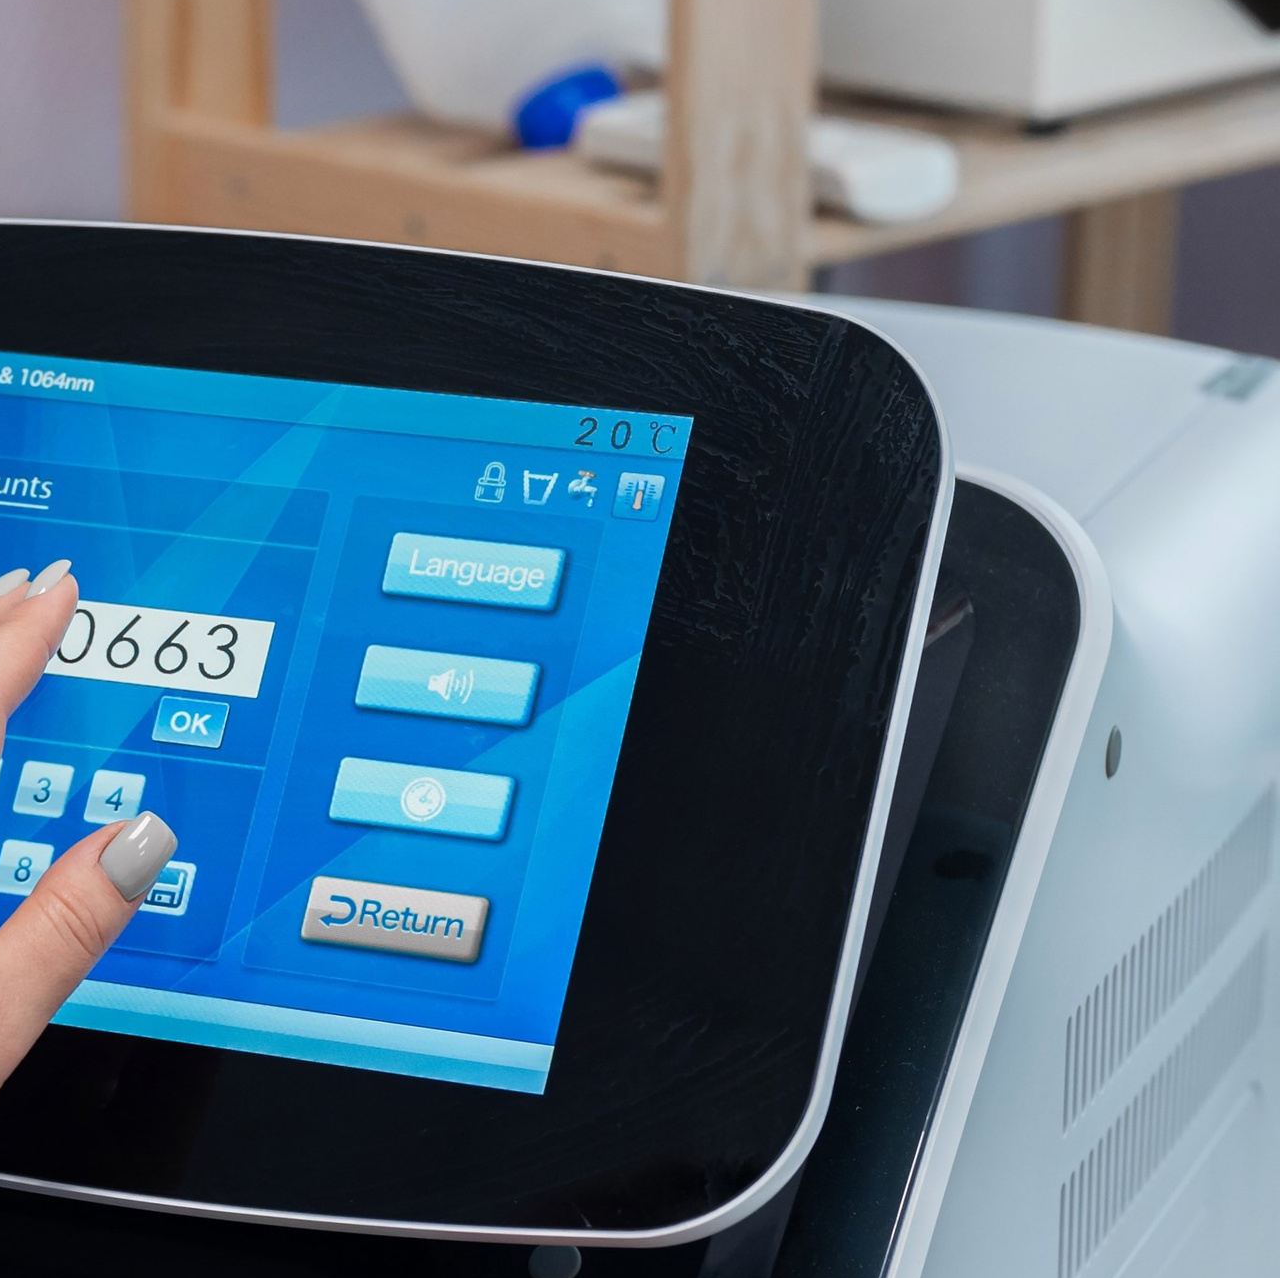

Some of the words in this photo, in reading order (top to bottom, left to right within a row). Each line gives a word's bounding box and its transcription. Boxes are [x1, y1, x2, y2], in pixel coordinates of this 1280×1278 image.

[21, 368, 95, 393] 1064nm
[409, 548, 546, 593] Language
[169, 710, 213, 736] OK
[32, 777, 52, 804] 3
[105, 786, 124, 812] 4
[13, 856, 33, 883] 8
[358, 899, 464, 939] Return
